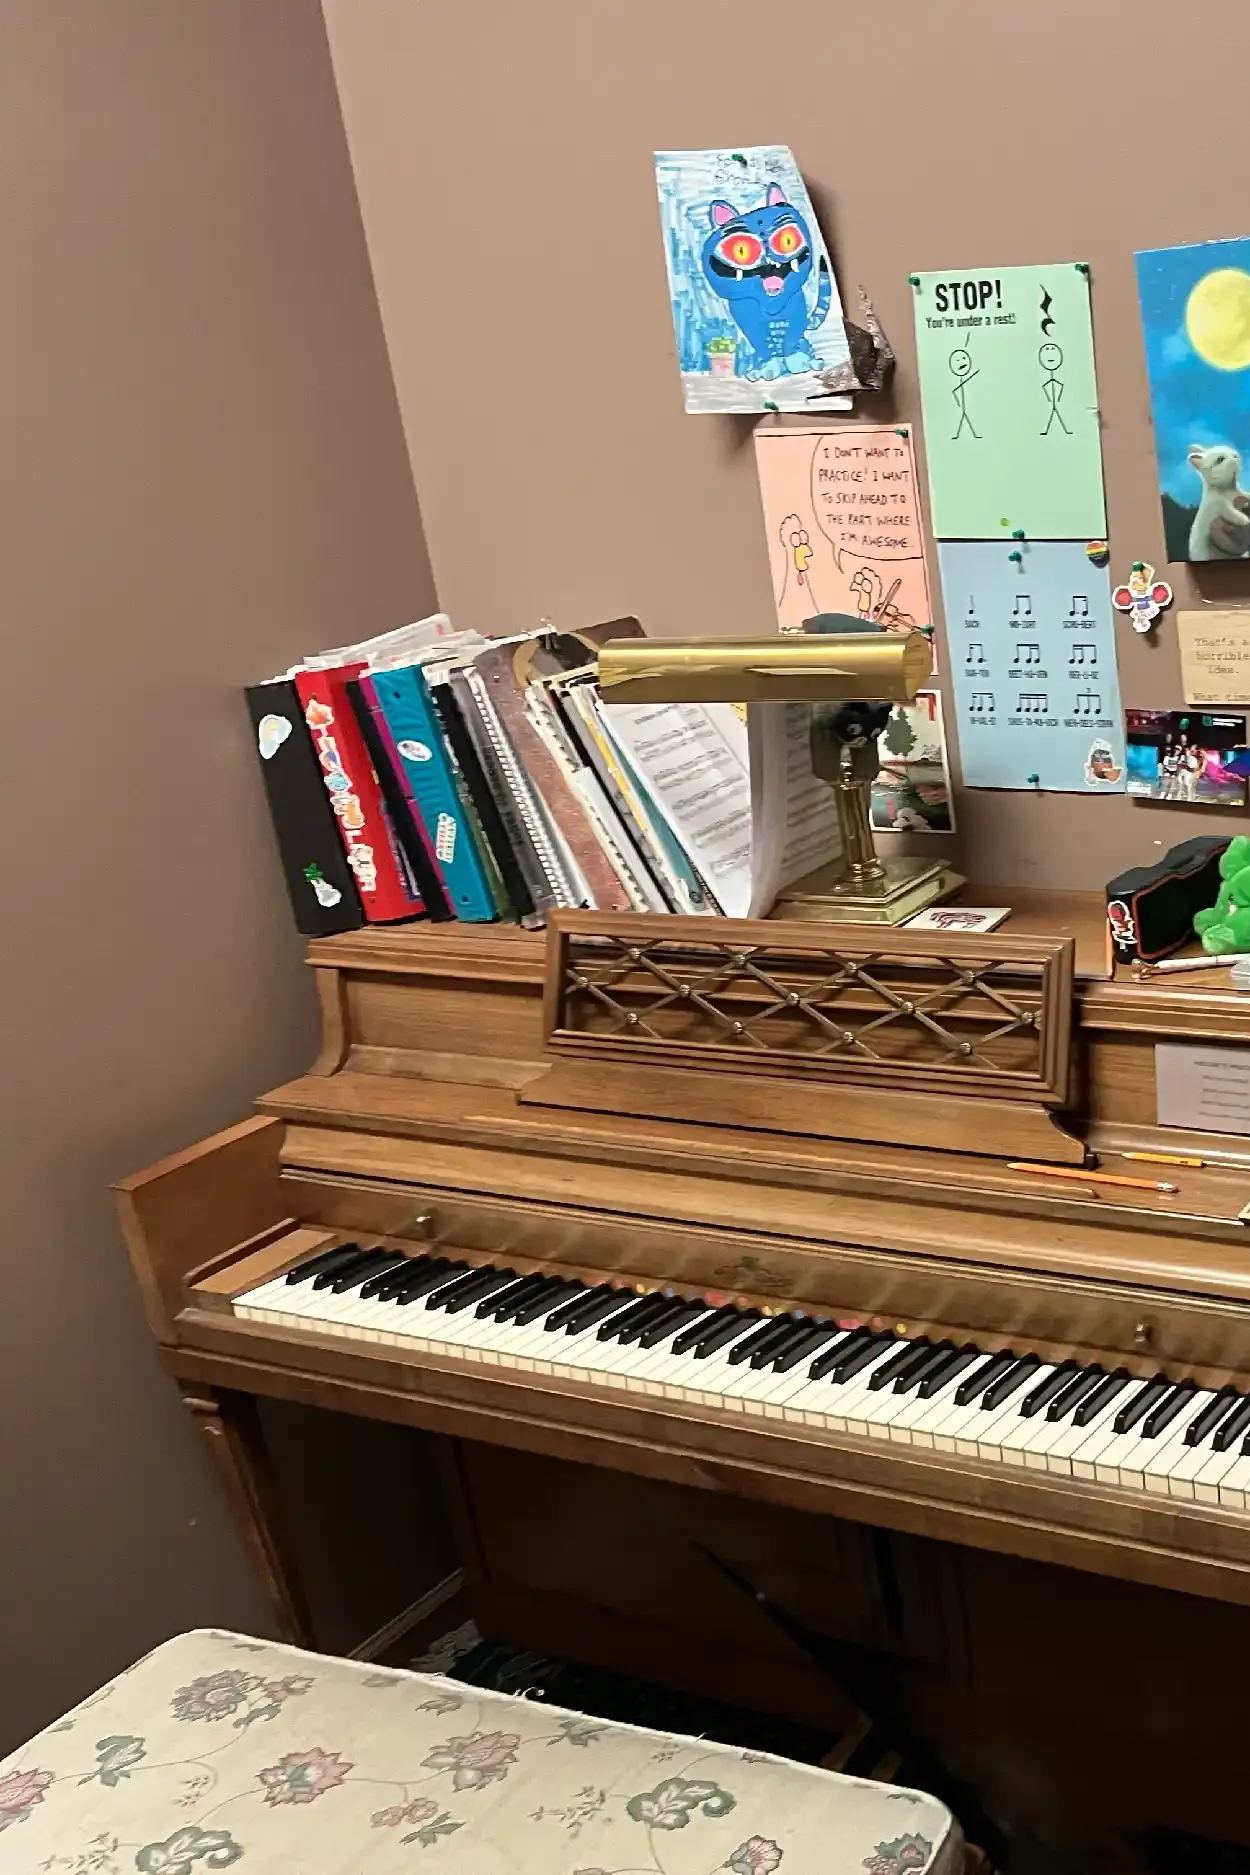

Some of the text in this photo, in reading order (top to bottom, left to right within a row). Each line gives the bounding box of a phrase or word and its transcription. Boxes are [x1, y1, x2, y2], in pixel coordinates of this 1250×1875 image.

[935, 280, 1003, 312] STOP!
[925, 317, 954, 329] You're
[957, 315, 983, 327] under
[985, 316, 991, 325] a
[865, 447, 890, 458] WANT
[872, 470, 878, 481] I
[882, 470, 909, 482] WANT
[836, 492, 856, 504] SKIP
[860, 494, 887, 505] AHEAD
[889, 494, 906, 504] TO
[826, 513, 910, 526] THE PART WHERE
[1194, 638, 1249, 647] That's a
[1196, 651, 1250, 661] horrible
